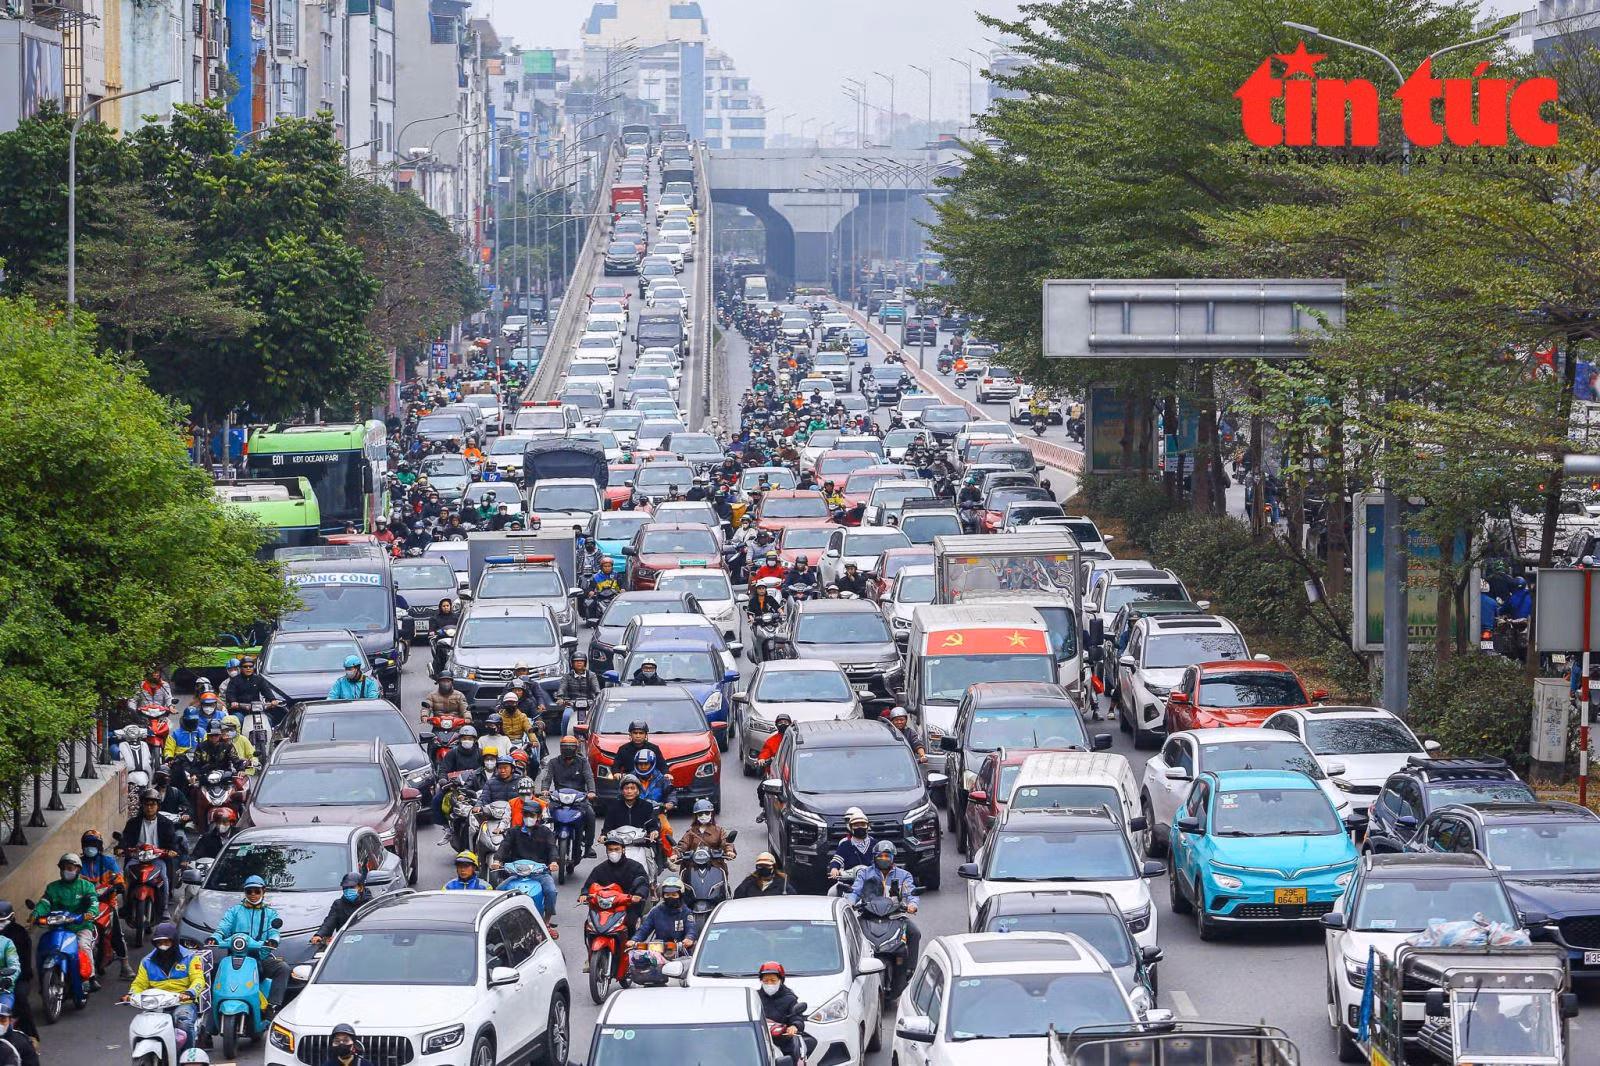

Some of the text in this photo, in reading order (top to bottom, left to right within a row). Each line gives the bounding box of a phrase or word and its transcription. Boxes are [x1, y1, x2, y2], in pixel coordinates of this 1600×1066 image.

[272, 455, 284, 466] E01
[304, 455, 324, 463] OCEAN
[290, 573, 378, 584] OÀNG CÔNG
[1407, 625, 1438, 636] CITY
